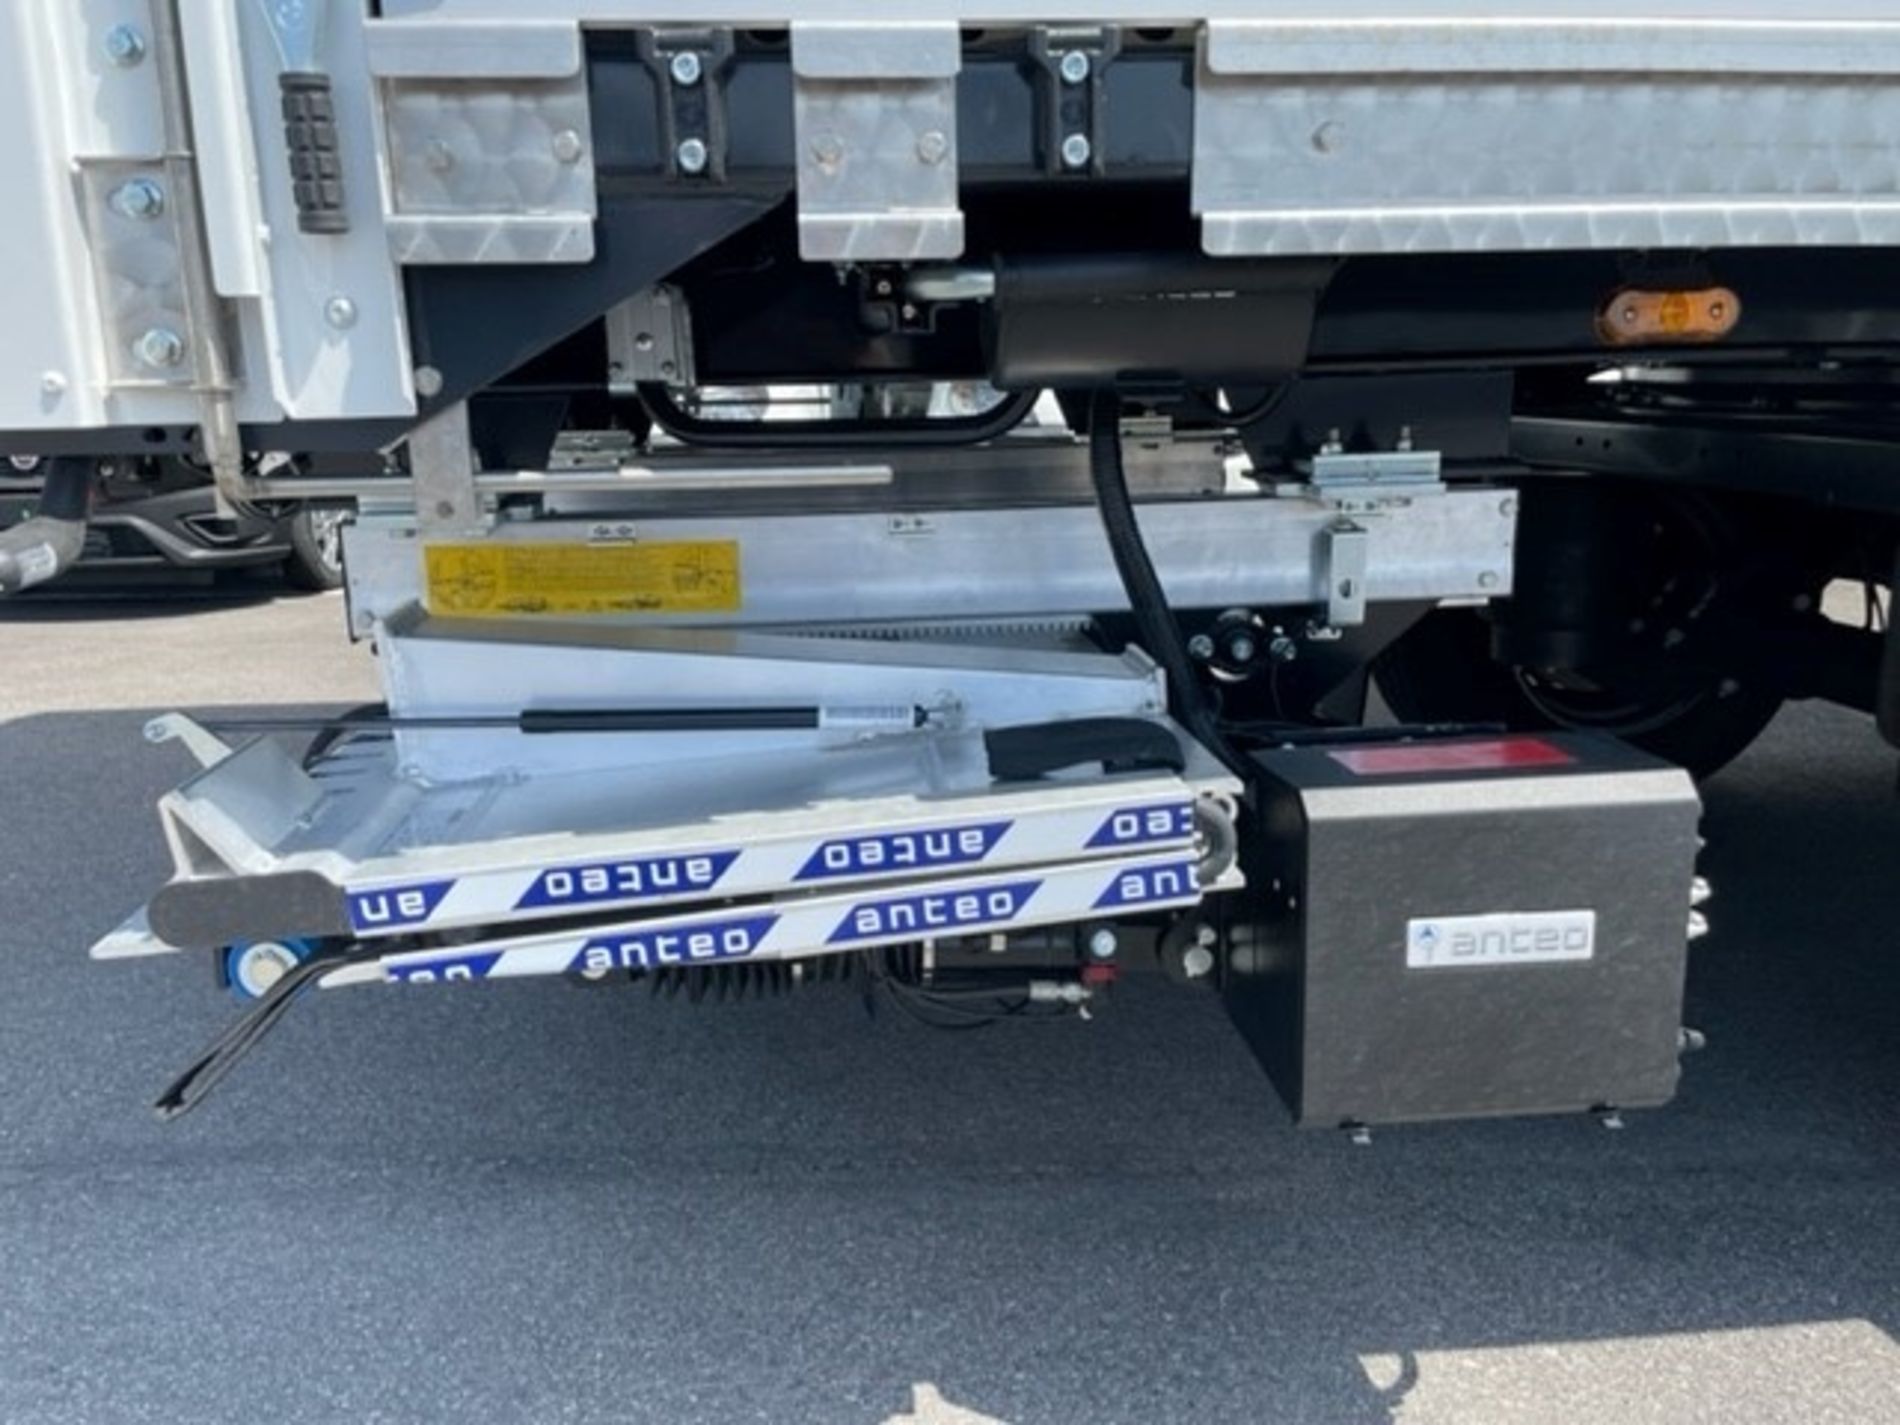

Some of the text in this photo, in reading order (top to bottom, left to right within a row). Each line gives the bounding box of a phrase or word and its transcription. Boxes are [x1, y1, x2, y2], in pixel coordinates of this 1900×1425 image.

[824, 829, 985, 869] anteo
[546, 857, 713, 897] anteo
[855, 890, 1014, 935] anteo
[585, 928, 753, 971] anteo
[1451, 926, 1588, 957] anteo
